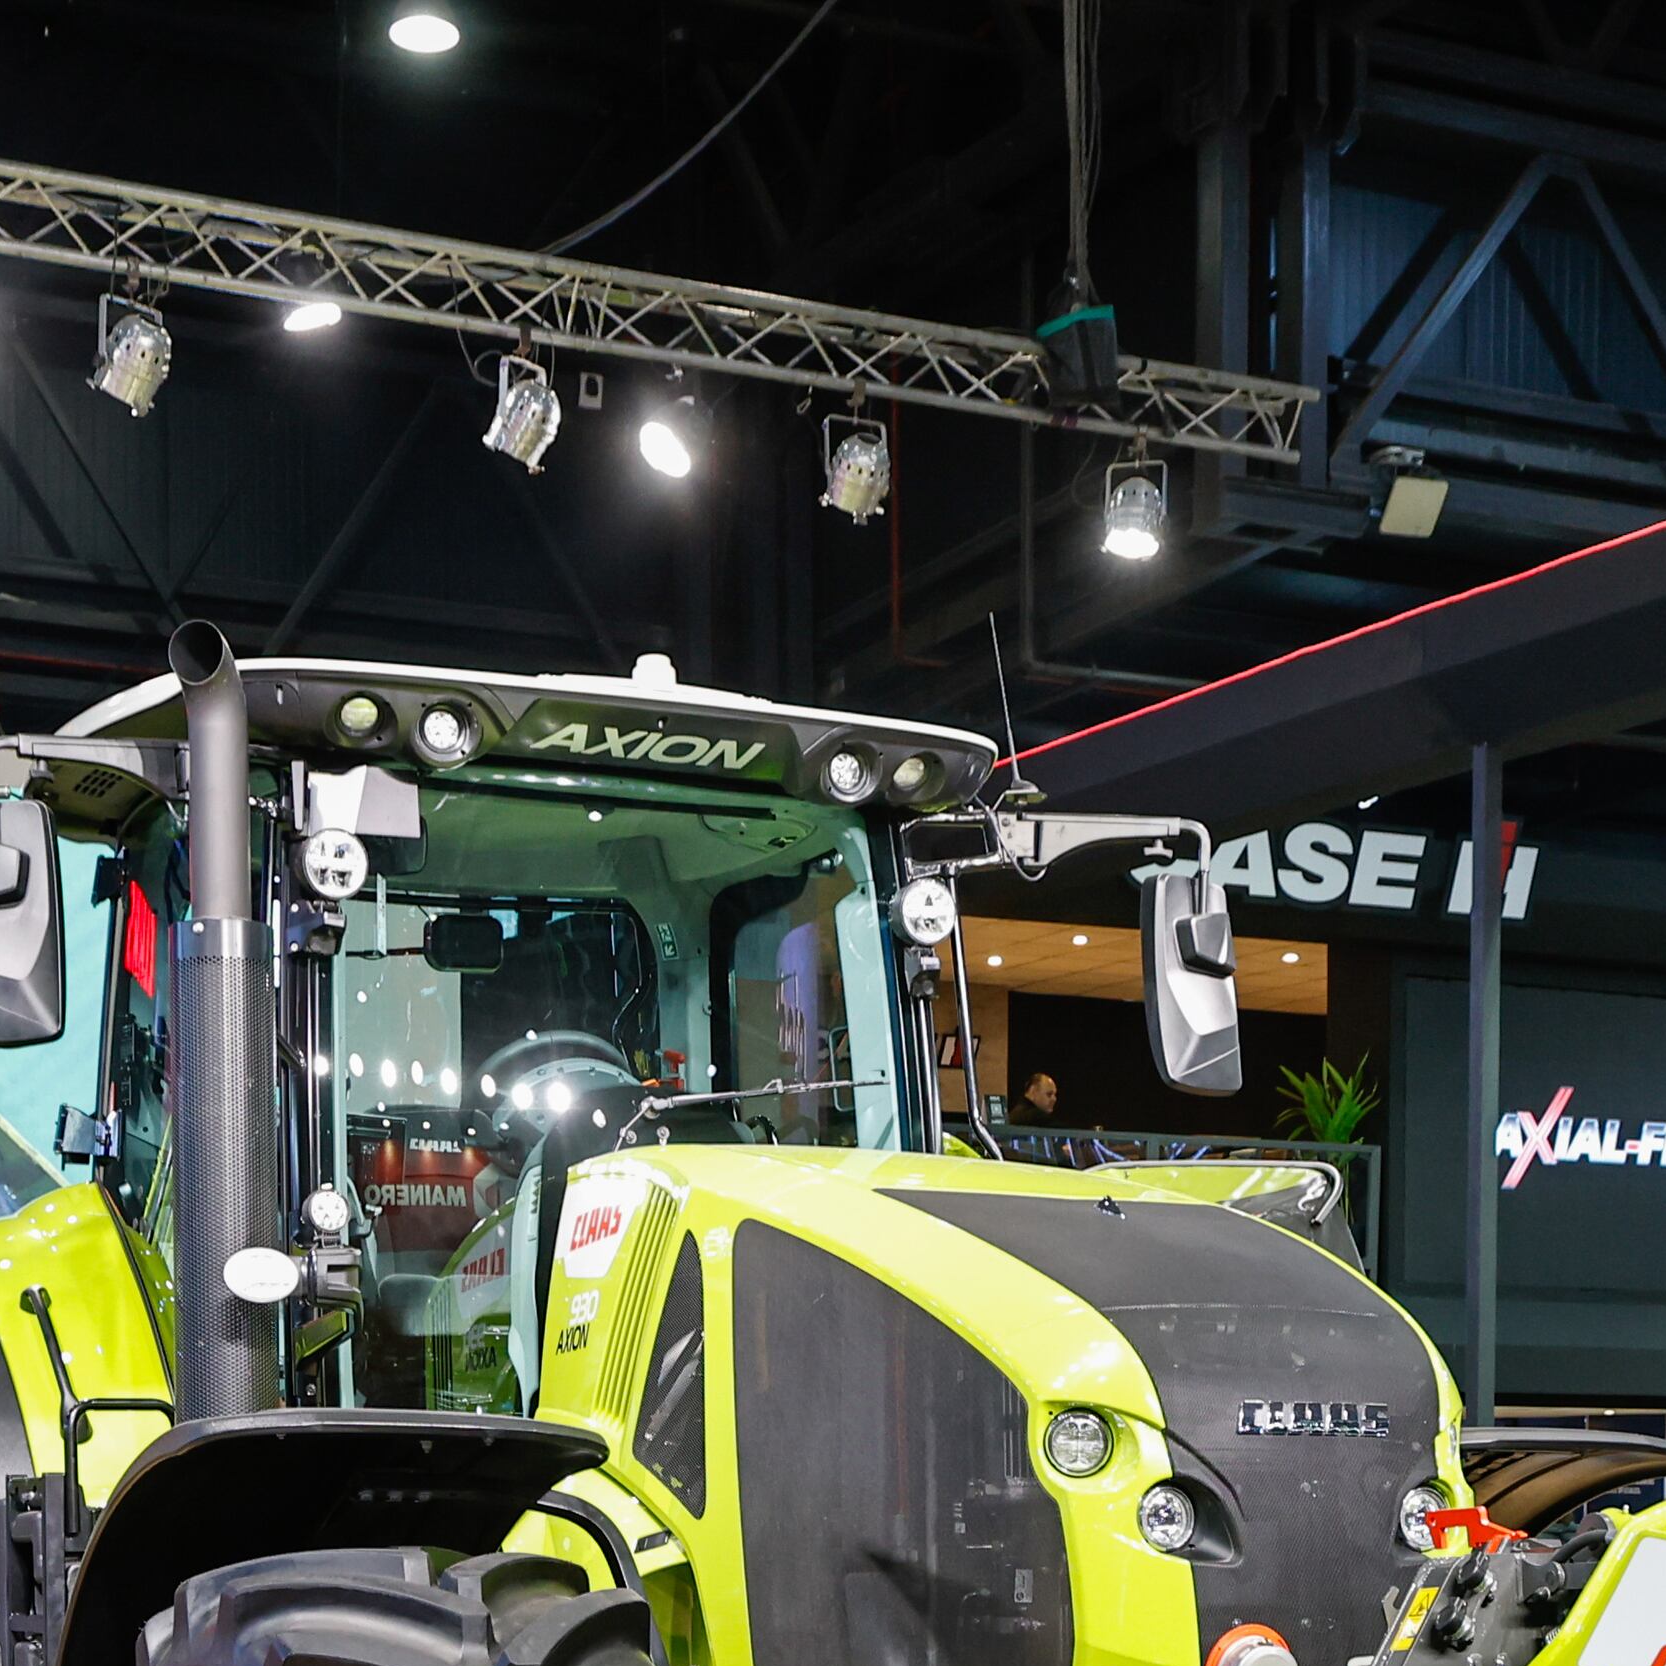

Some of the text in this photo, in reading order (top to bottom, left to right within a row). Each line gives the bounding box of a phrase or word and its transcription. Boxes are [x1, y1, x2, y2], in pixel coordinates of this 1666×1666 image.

[533, 722, 766, 770] AXION
[570, 1206, 622, 1252] CLAAS
[569, 1289, 600, 1325] 930
[555, 1324, 590, 1355] AXION
[1237, 1399, 1389, 1436] CLAAS
